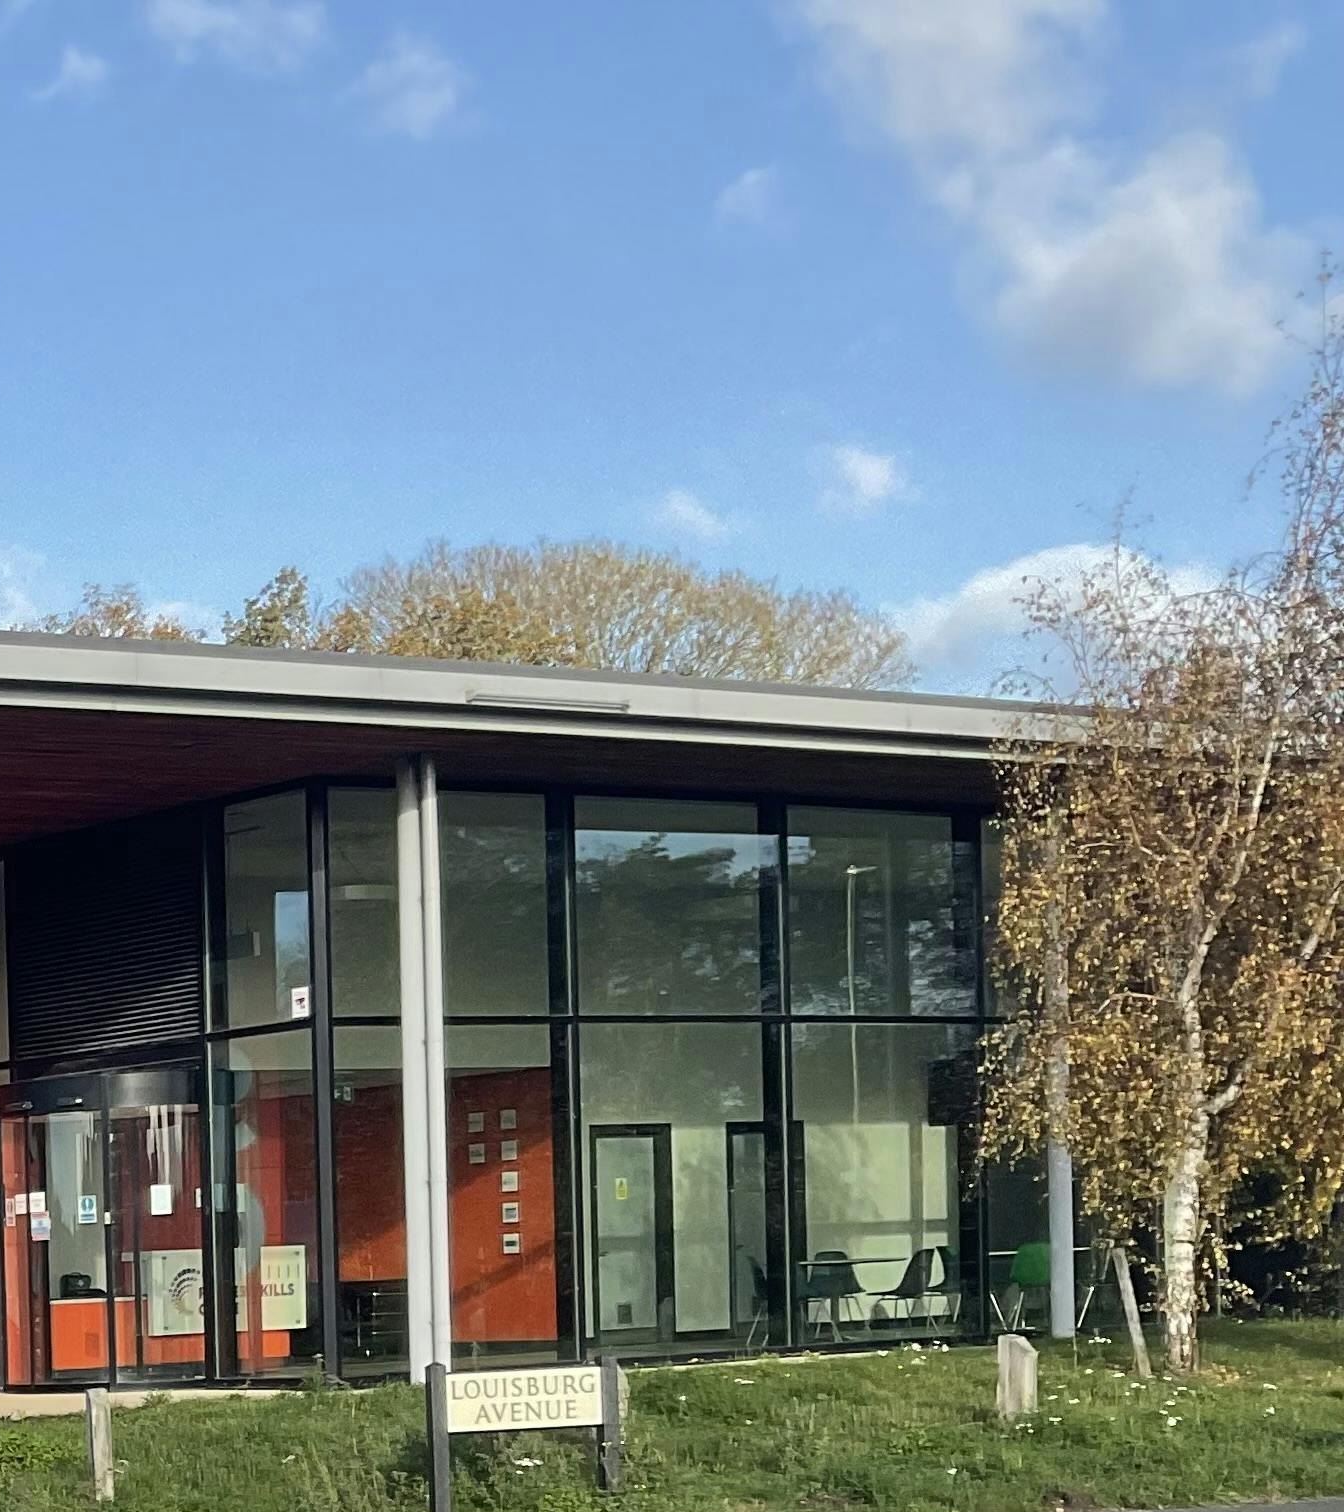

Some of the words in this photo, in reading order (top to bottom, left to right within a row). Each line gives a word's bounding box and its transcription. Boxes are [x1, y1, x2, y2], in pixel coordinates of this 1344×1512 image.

[254, 1283, 295, 1297] KILLS
[451, 1373, 596, 1400] LOUISBURG
[474, 1399, 578, 1425] AVENUE
